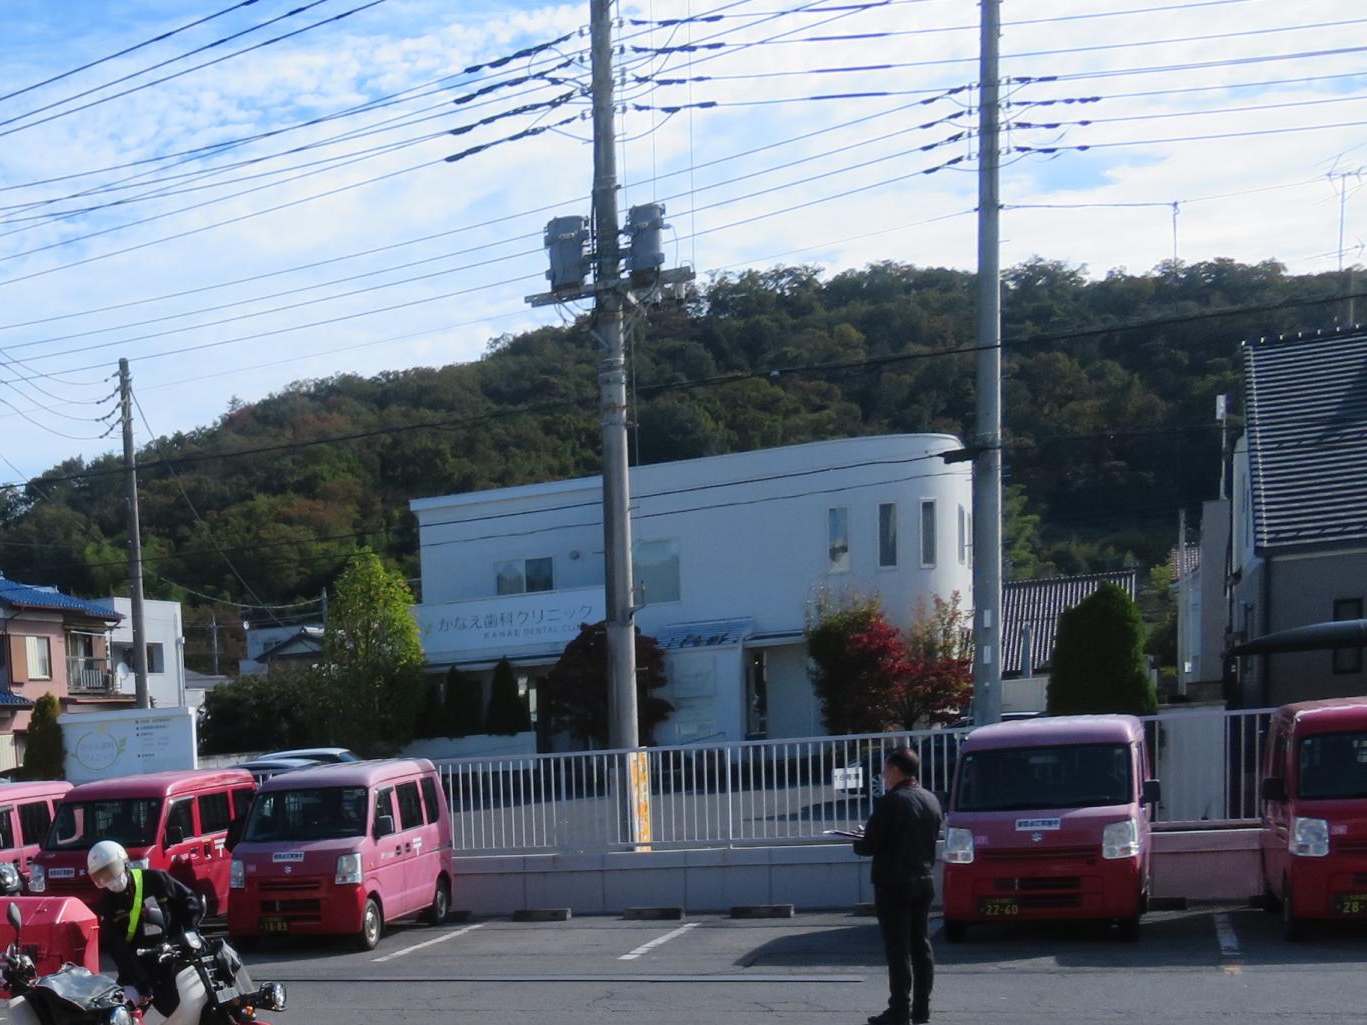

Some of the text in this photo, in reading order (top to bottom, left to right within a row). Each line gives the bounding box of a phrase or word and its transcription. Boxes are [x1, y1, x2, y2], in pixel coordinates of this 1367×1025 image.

[438, 604, 593, 633] かなえ歯科クリニック
[484, 629, 520, 639] KANAE
[523, 625, 558, 636] DENTAL
